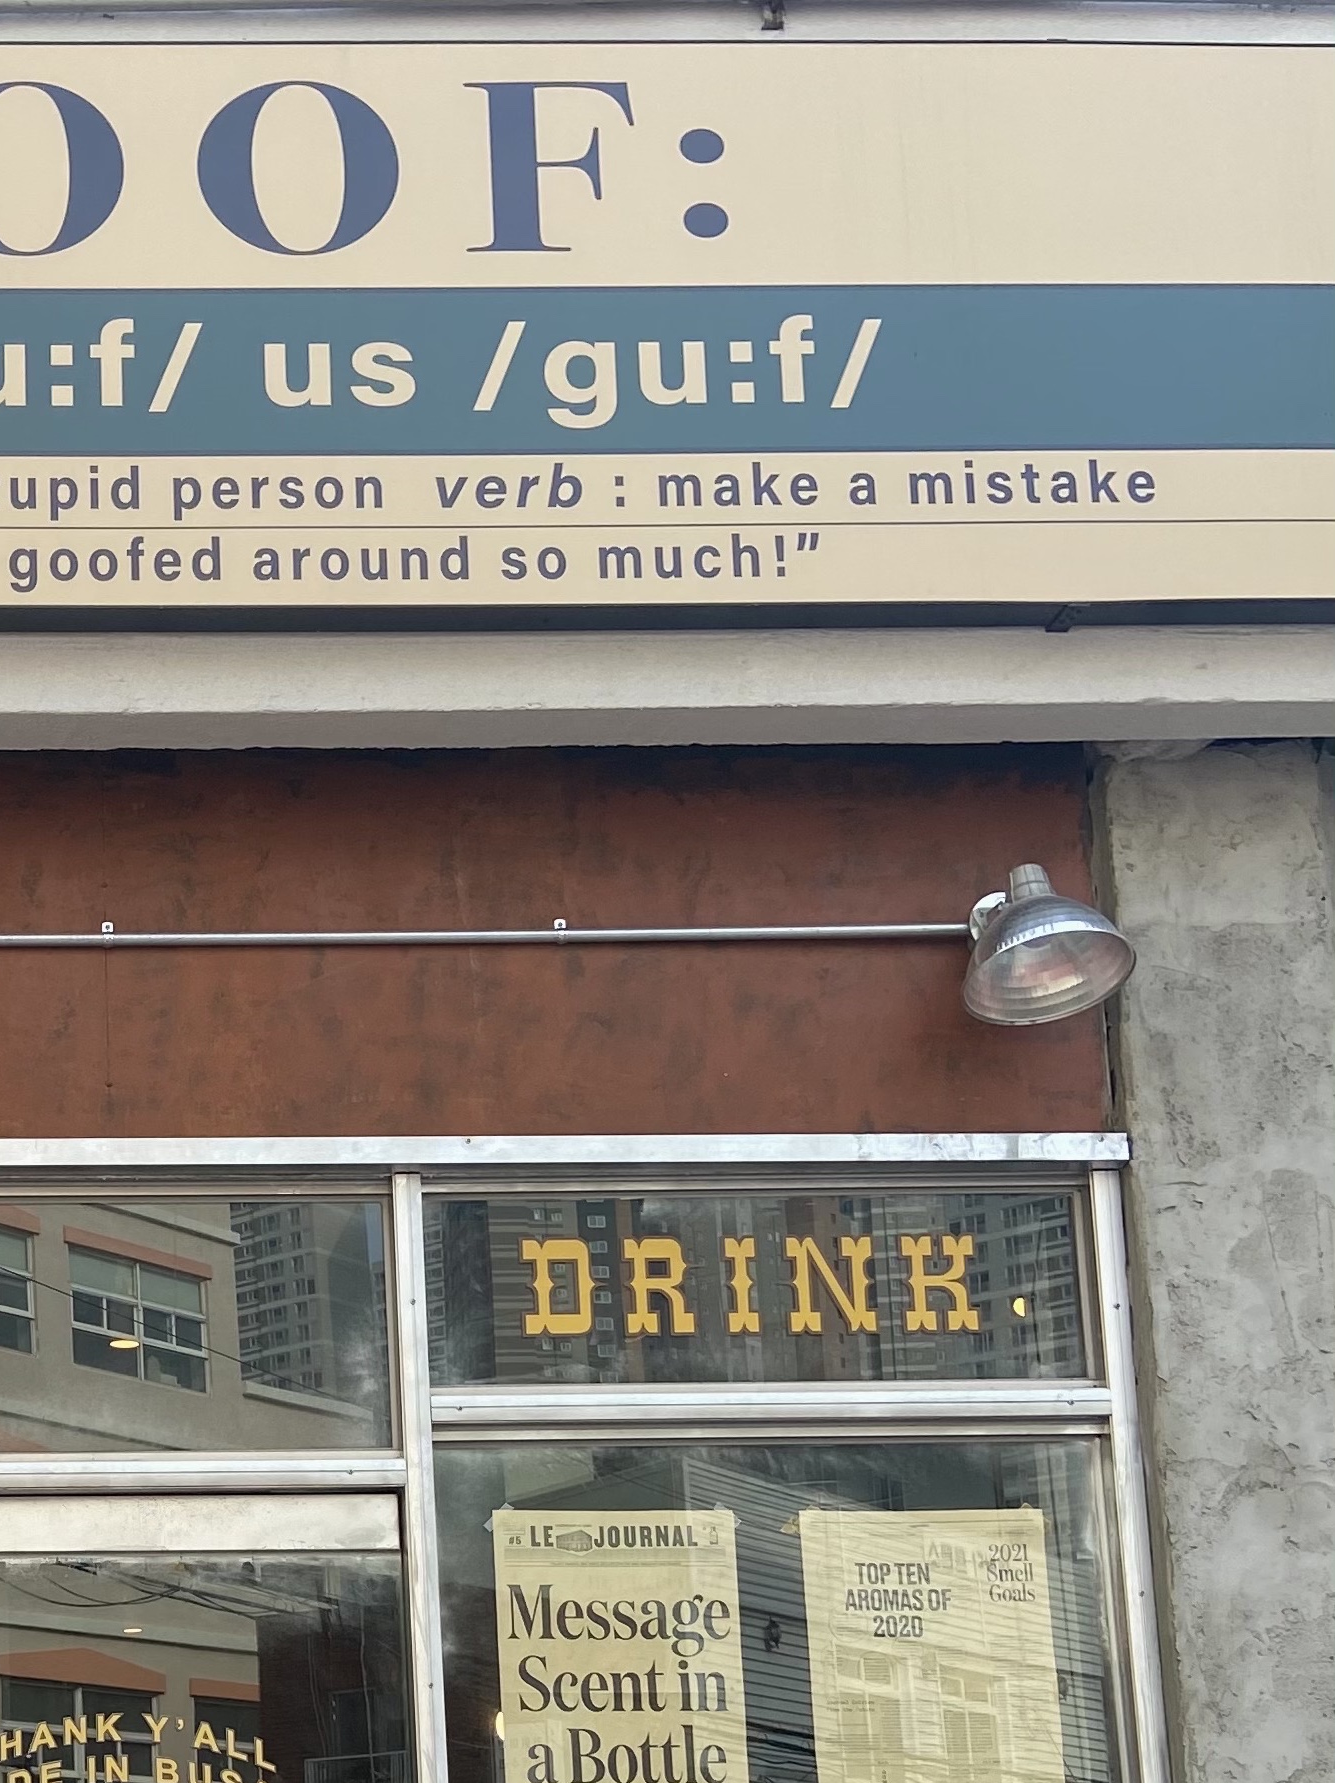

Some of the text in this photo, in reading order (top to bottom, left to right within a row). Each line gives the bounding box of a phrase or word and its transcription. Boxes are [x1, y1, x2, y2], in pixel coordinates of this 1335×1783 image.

[264, 337, 417, 408] us
[472, 315, 882, 430] /gu:f/
[172, 471, 385, 521] person
[434, 462, 585, 510] verb
[656, 462, 819, 508] make
[849, 472, 878, 508] a
[907, 459, 1158, 508] mistake
[7, 535, 223, 592] goofed
[251, 534, 471, 582] around
[500, 545, 569, 581] so
[518, 1233, 980, 1338] DRINK
[529, 1525, 555, 1547] LE
[593, 1525, 699, 1549] JOURNAL
[988, 1543, 1029, 1562] 2021
[855, 1562, 931, 1585] TOP TEN
[987, 1562, 1034, 1582] Smell
[845, 1588, 952, 1612] AROMAS OF
[988, 1583, 1036, 1603] Goals
[507, 1583, 732, 1657] Message
[872, 1614, 924, 1638] 2020
[518, 1654, 729, 1713] Scent in
